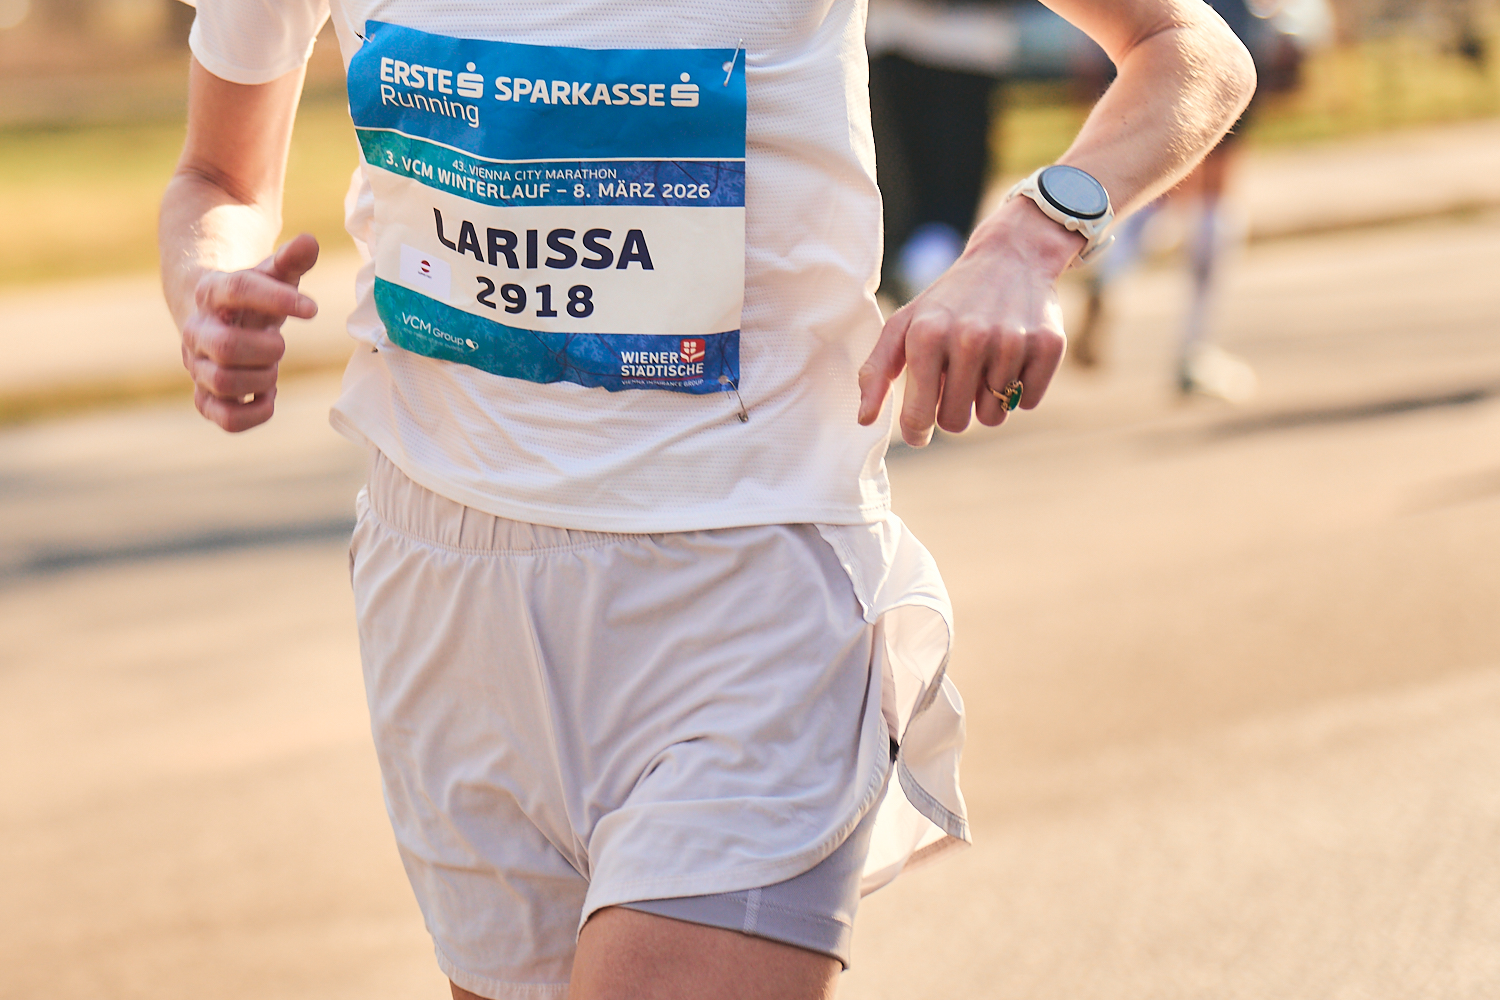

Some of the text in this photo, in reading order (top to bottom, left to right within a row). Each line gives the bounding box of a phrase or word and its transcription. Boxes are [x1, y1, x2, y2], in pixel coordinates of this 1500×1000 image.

[380, 56, 666, 107] ERSTE SPARKASSE
[380, 83, 480, 129] Running
[385, 150, 399, 168] 3.
[401, 155, 433, 180] VCM
[437, 167, 551, 199] WINTERLAUF
[573, 183, 591, 198] 8.
[598, 179, 655, 199] MÄRZ
[662, 183, 711, 199] 2026
[452, 159, 617, 181] 43. VIENNA CITY MARATHON
[433, 206, 655, 271] LARISSA
[475, 275, 595, 319] 2918
[401, 311, 432, 335] VCM
[432, 327, 465, 346] Group
[620, 351, 679, 364] WIENER
[621, 362, 704, 377] STÄDTISCHE
[683, 379, 704, 388] GROUP
